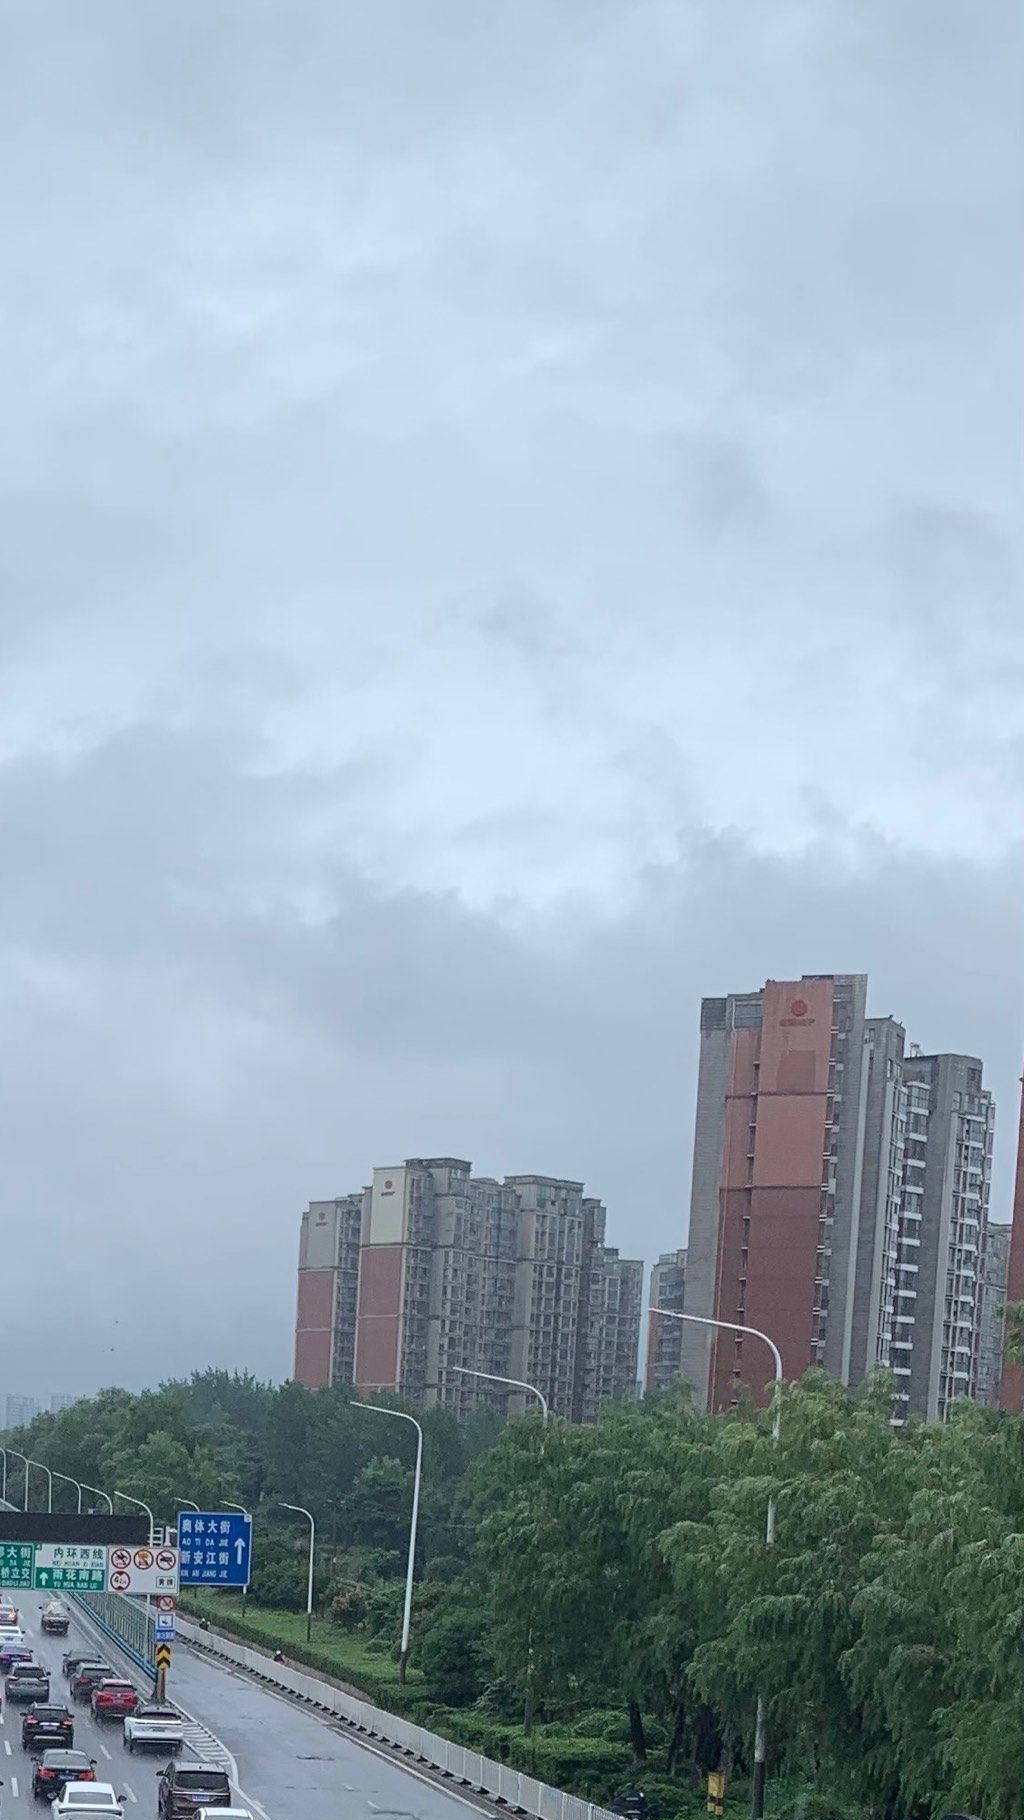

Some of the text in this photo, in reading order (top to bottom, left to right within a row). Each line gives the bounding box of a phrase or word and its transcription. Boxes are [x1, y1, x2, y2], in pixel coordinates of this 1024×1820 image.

[182, 1519, 230, 1534] 奥体大街
[182, 1538, 229, 1547] AO TI DA JIE
[54, 1547, 103, 1560] 内环西线
[181, 1550, 229, 1565] 新安江街
[53, 1569, 103, 1581] 雨花南路
